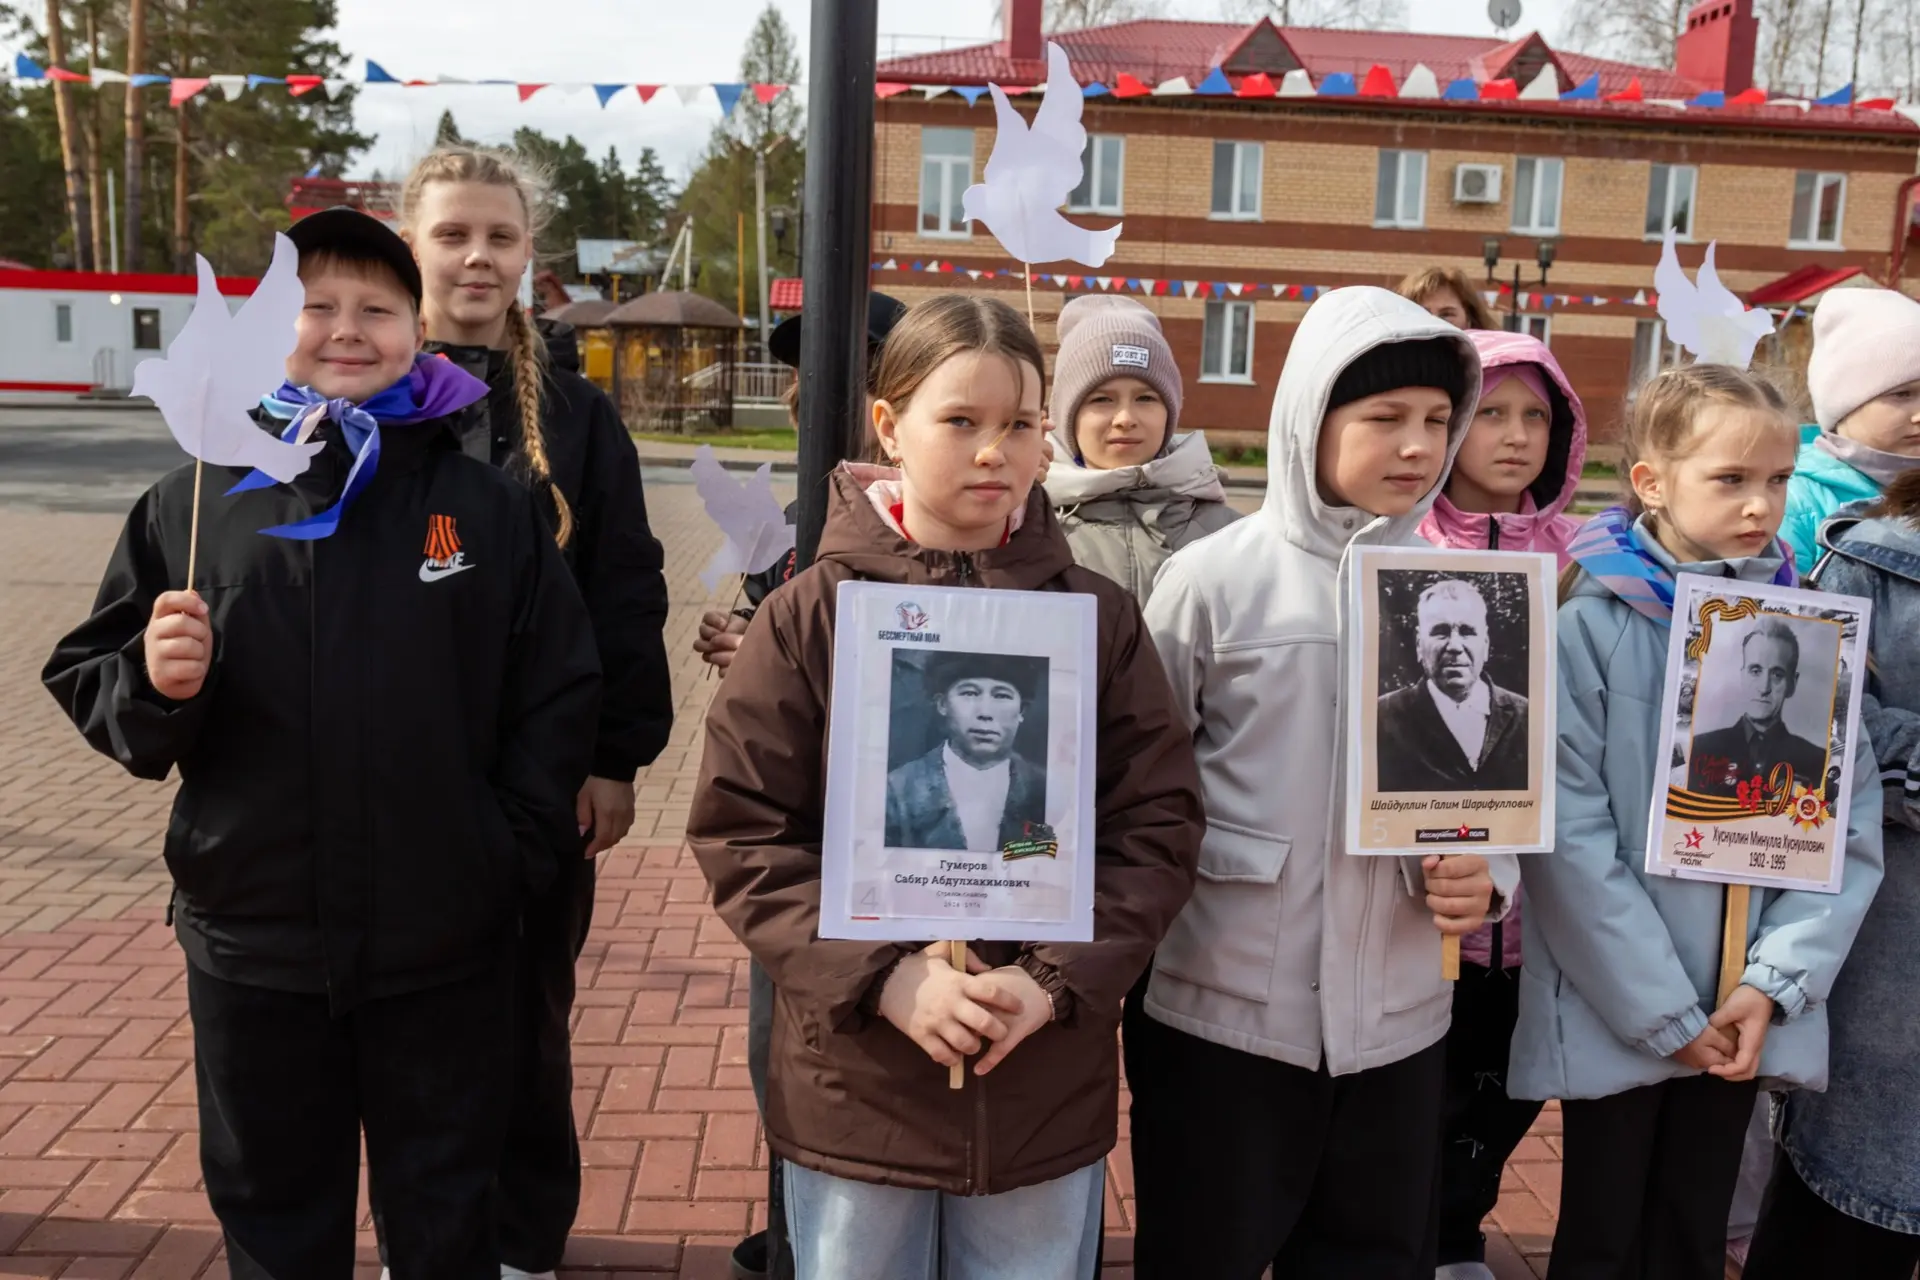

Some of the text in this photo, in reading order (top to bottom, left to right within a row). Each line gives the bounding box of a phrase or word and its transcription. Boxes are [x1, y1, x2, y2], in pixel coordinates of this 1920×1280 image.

[1371, 799, 1533, 812] Шайдуллин Галим Шарифуллович
[1712, 825, 1826, 855] Хуснуллин Минулла Хуснуллович
[940, 859, 988, 871] Гумеров
[1748, 851, 1765, 868] 1902
[1770, 854, 1787, 870] 1995
[894, 874, 1030, 888] Сабир Абдулхакимович
